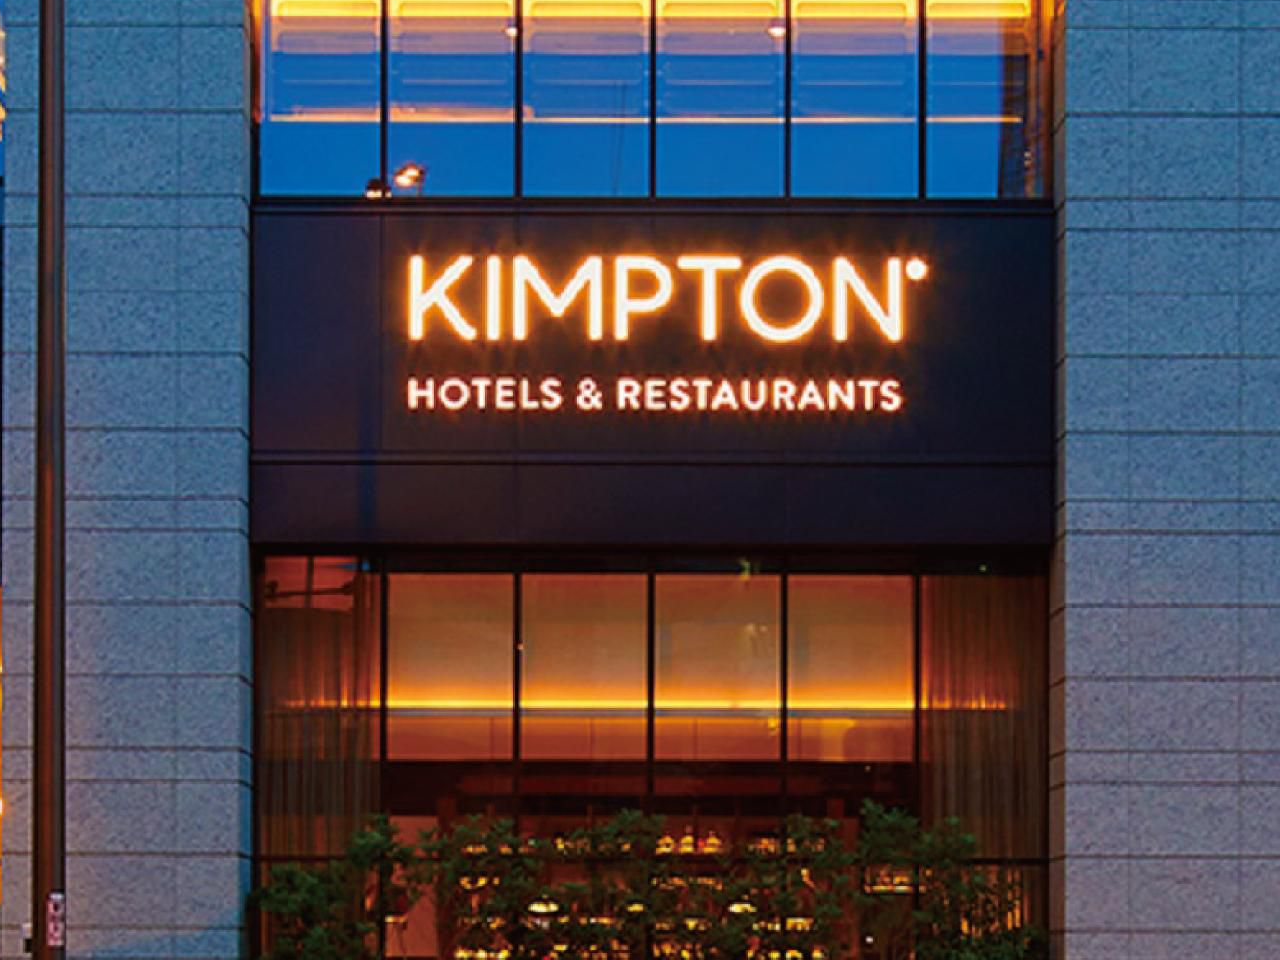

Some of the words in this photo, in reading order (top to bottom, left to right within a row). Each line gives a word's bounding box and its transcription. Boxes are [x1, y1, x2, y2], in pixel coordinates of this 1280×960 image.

[407, 254, 903, 342] KIMPTON
[407, 377, 562, 411] HOTELS
[576, 377, 603, 411] &
[617, 377, 903, 412] RESTAURANTS
